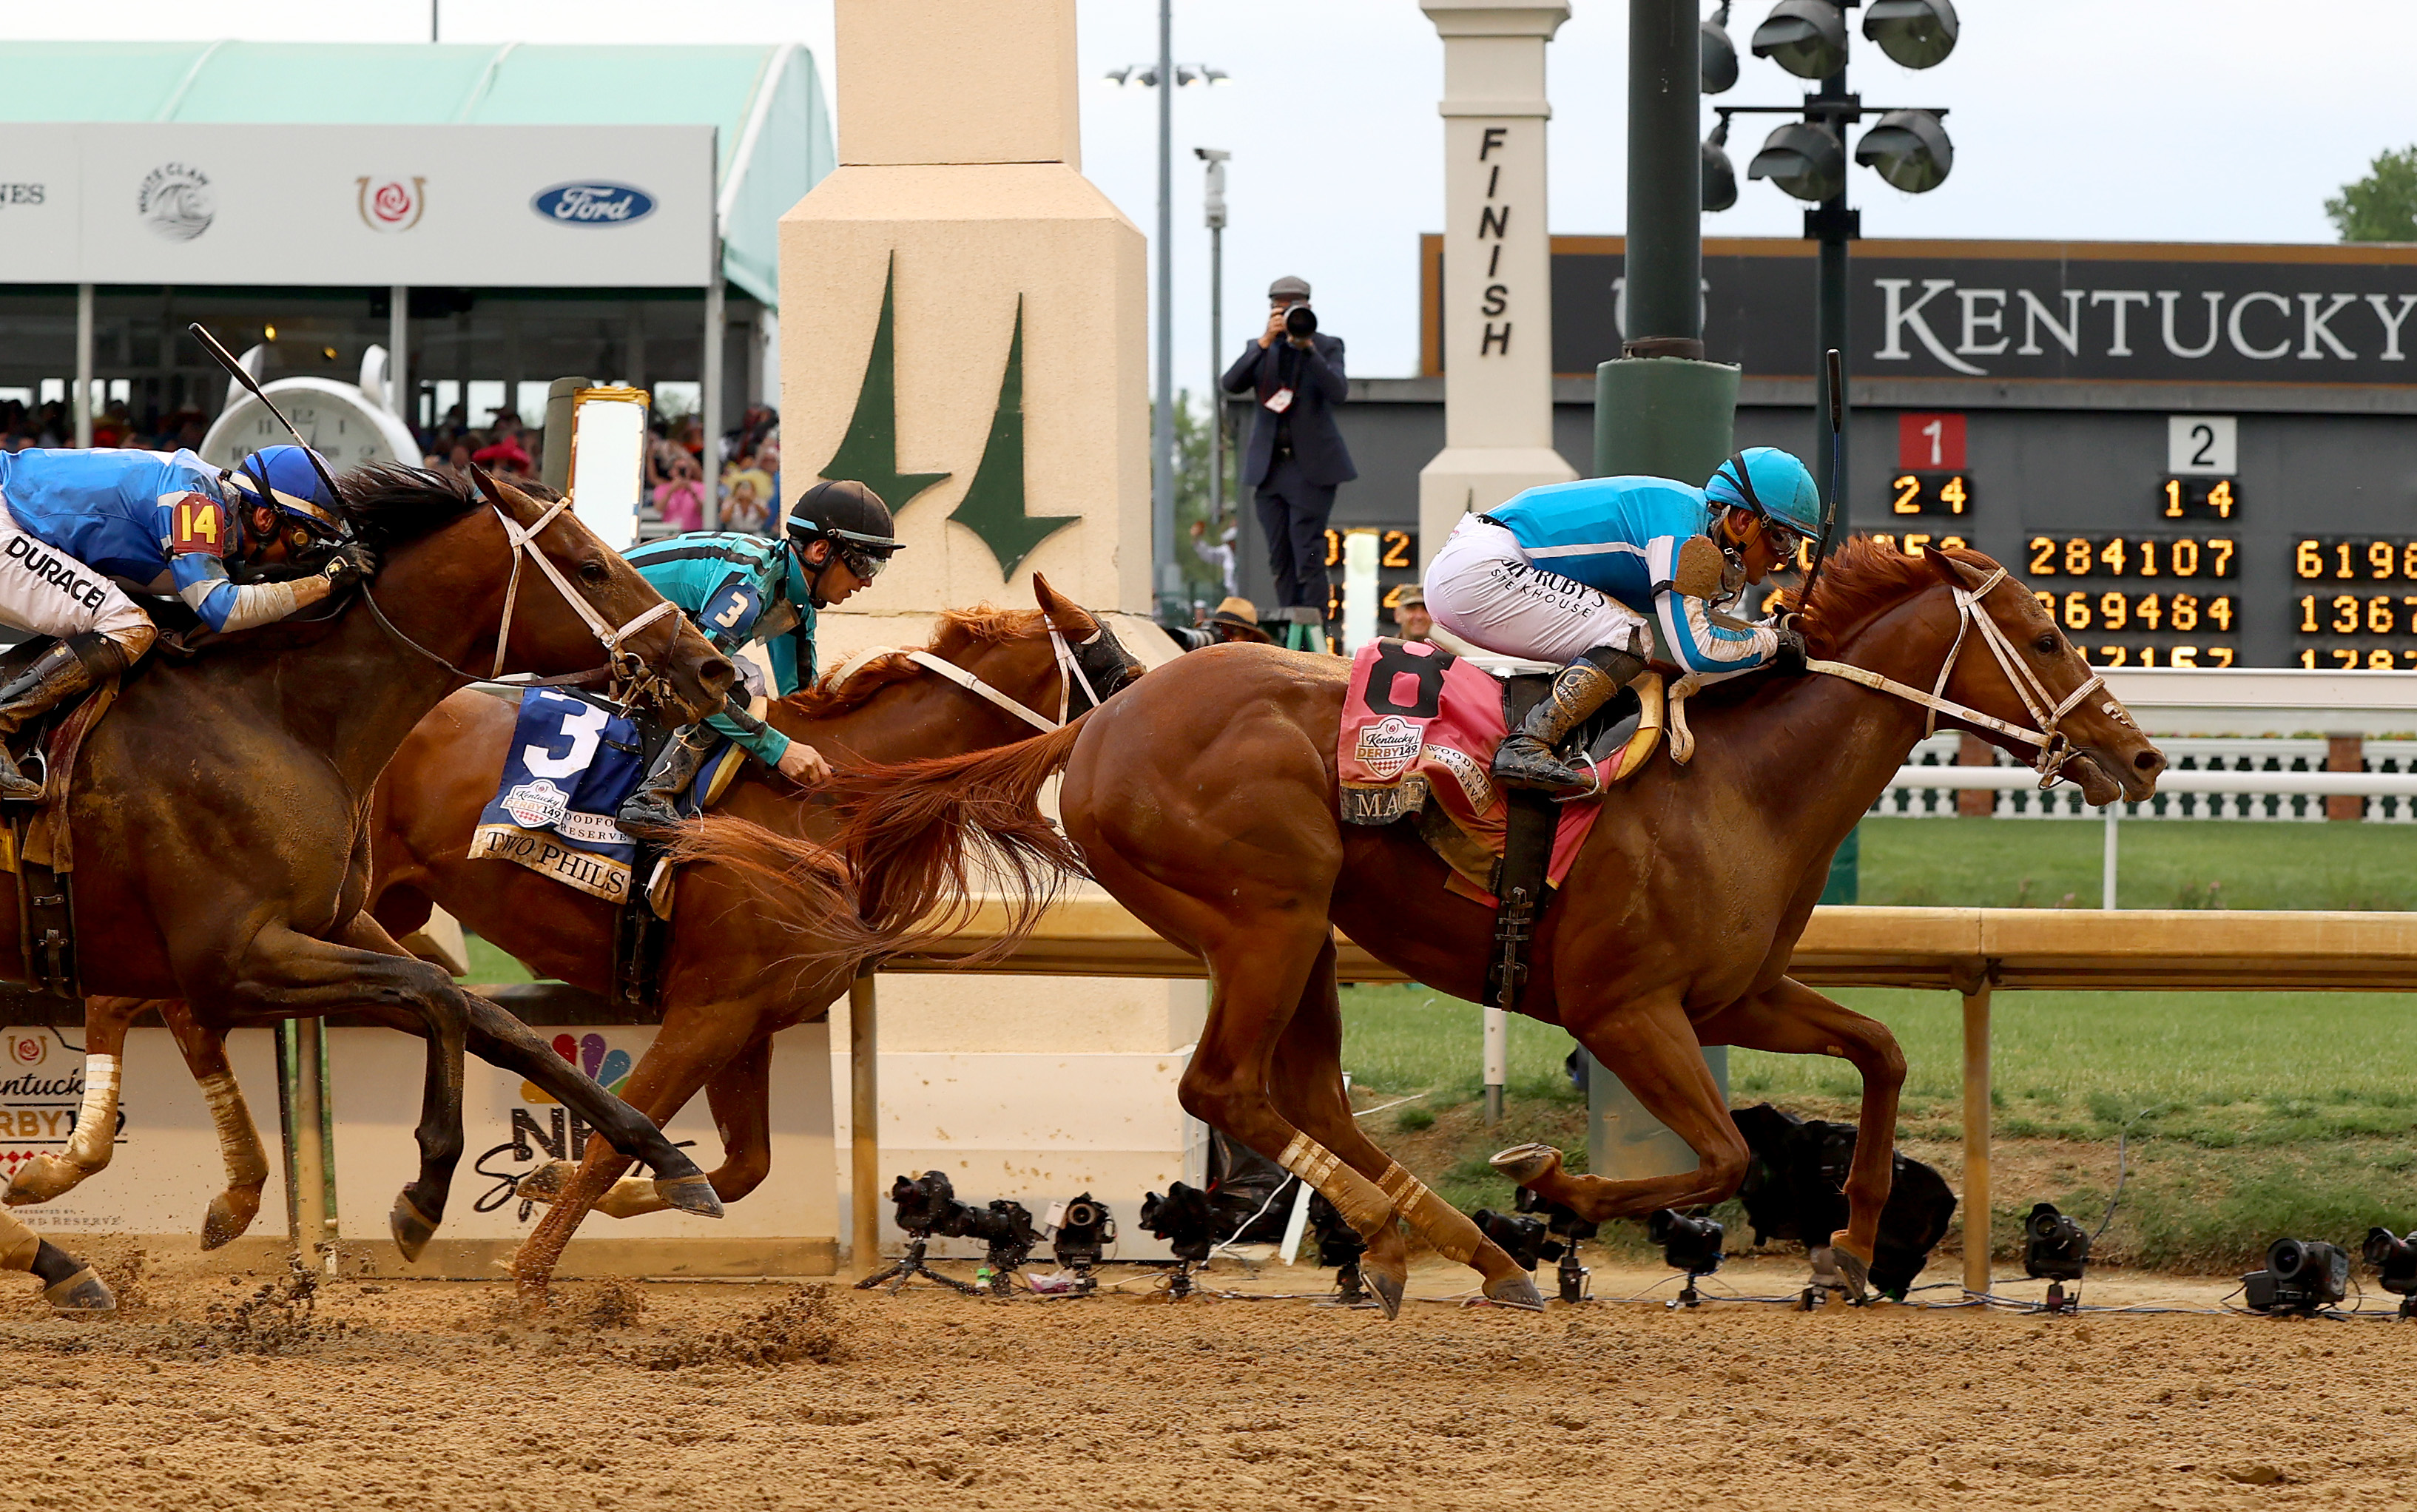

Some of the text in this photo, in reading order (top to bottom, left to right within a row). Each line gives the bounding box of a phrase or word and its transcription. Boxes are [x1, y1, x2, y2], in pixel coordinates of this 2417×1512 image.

[555, 186, 633, 220] Ford
[1479, 129, 1511, 356] FINISH
[1873, 278, 2417, 375] KENTUCKY
[1922, 419, 1942, 465] 1
[2191, 424, 2215, 467] 2
[181, 504, 217, 544] 14
[714, 591, 749, 628] 3
[1491, 569, 1591, 618] STEKHOUSE
[1363, 638, 1456, 718] 8
[522, 691, 610, 778] 3
[1366, 733, 1415, 747] Kentucky
[516, 790, 560, 809] Kentucky
[1434, 755, 1480, 807] RESERVE
[561, 823, 627, 841] RESERVE
[564, 812, 613, 827] OODFO
[486, 831, 536, 856] TWO
